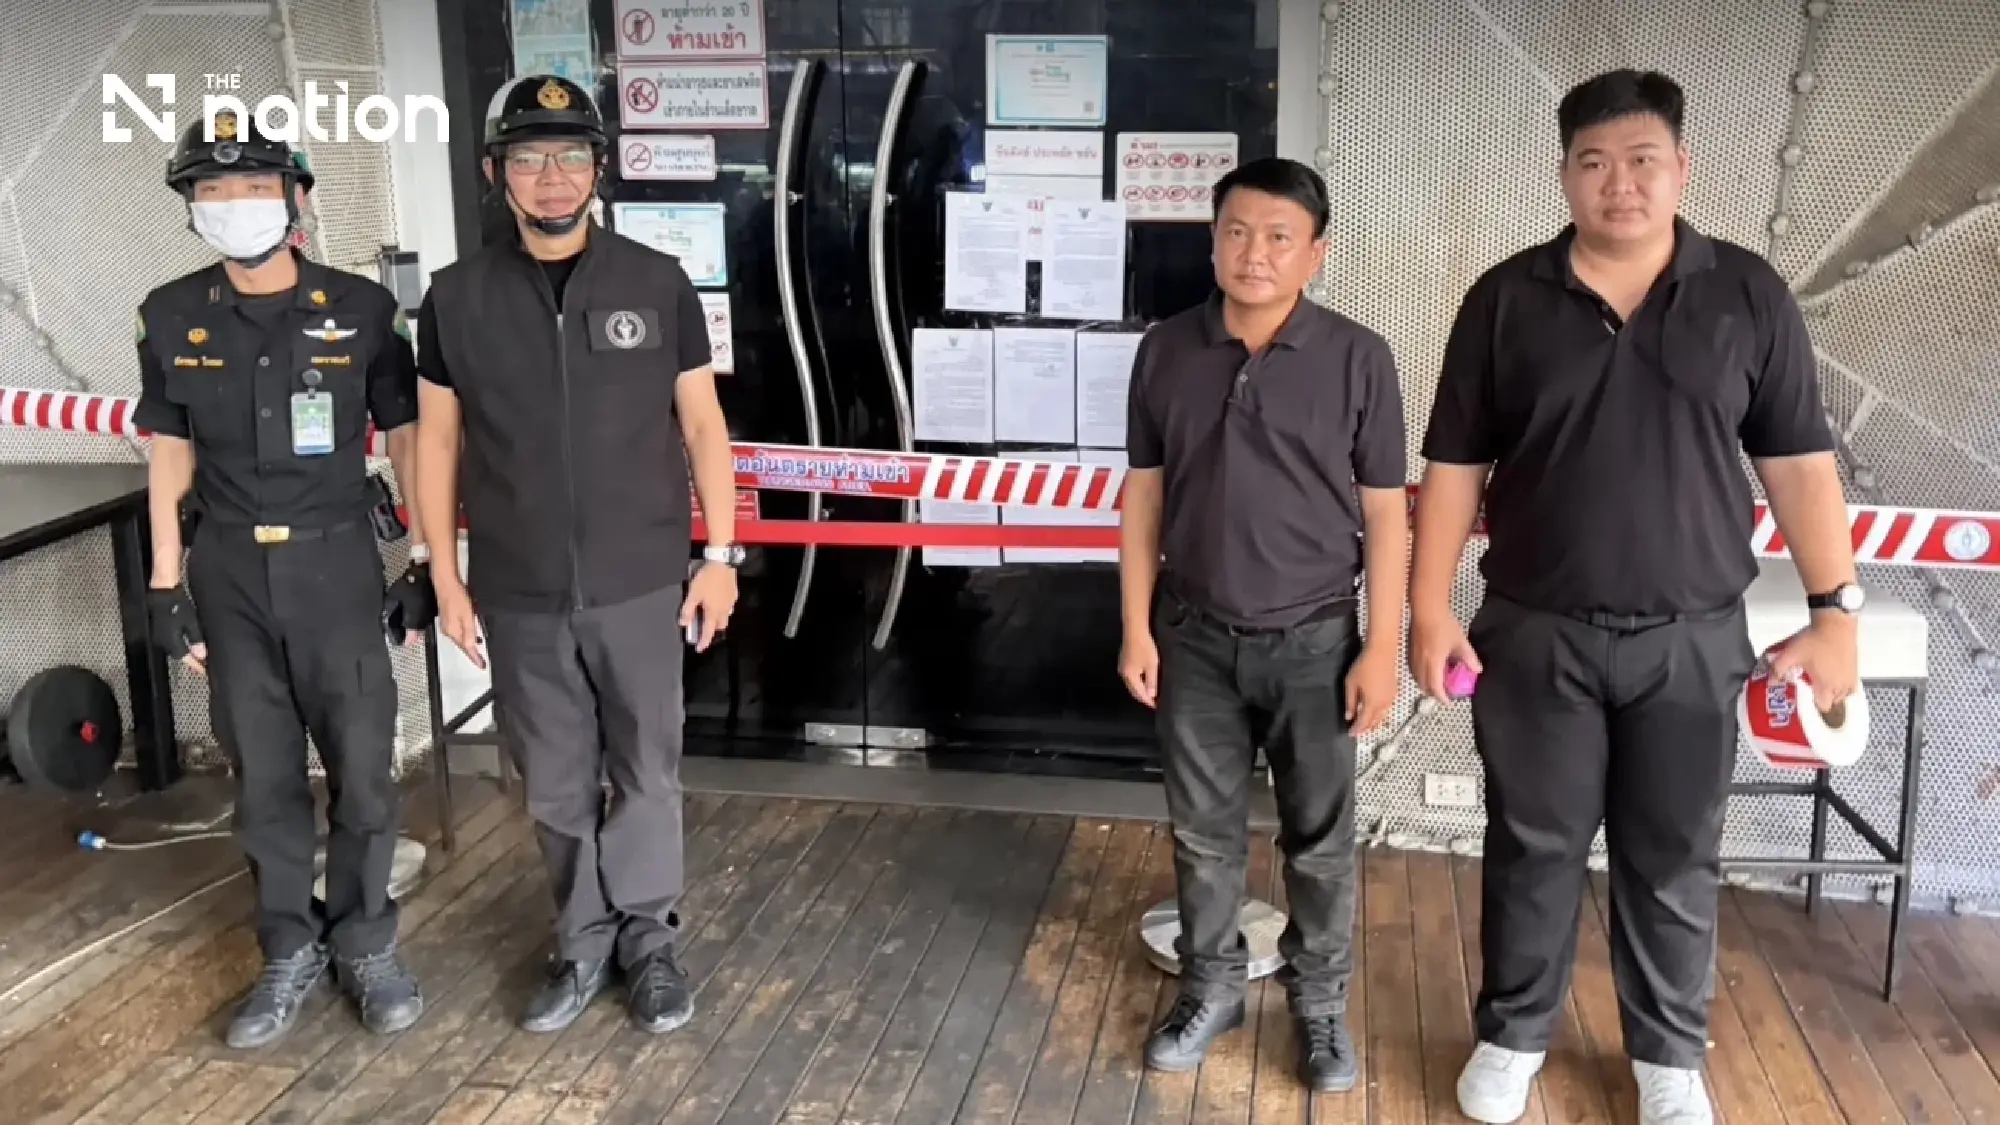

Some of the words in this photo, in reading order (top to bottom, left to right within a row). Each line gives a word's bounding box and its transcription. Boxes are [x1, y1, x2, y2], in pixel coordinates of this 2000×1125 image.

[722, 6, 735, 17] 20
[666, 23, 746, 49] ห้ามเข้า
[733, 449, 910, 483] ตอันตรายห้ามเข้า
